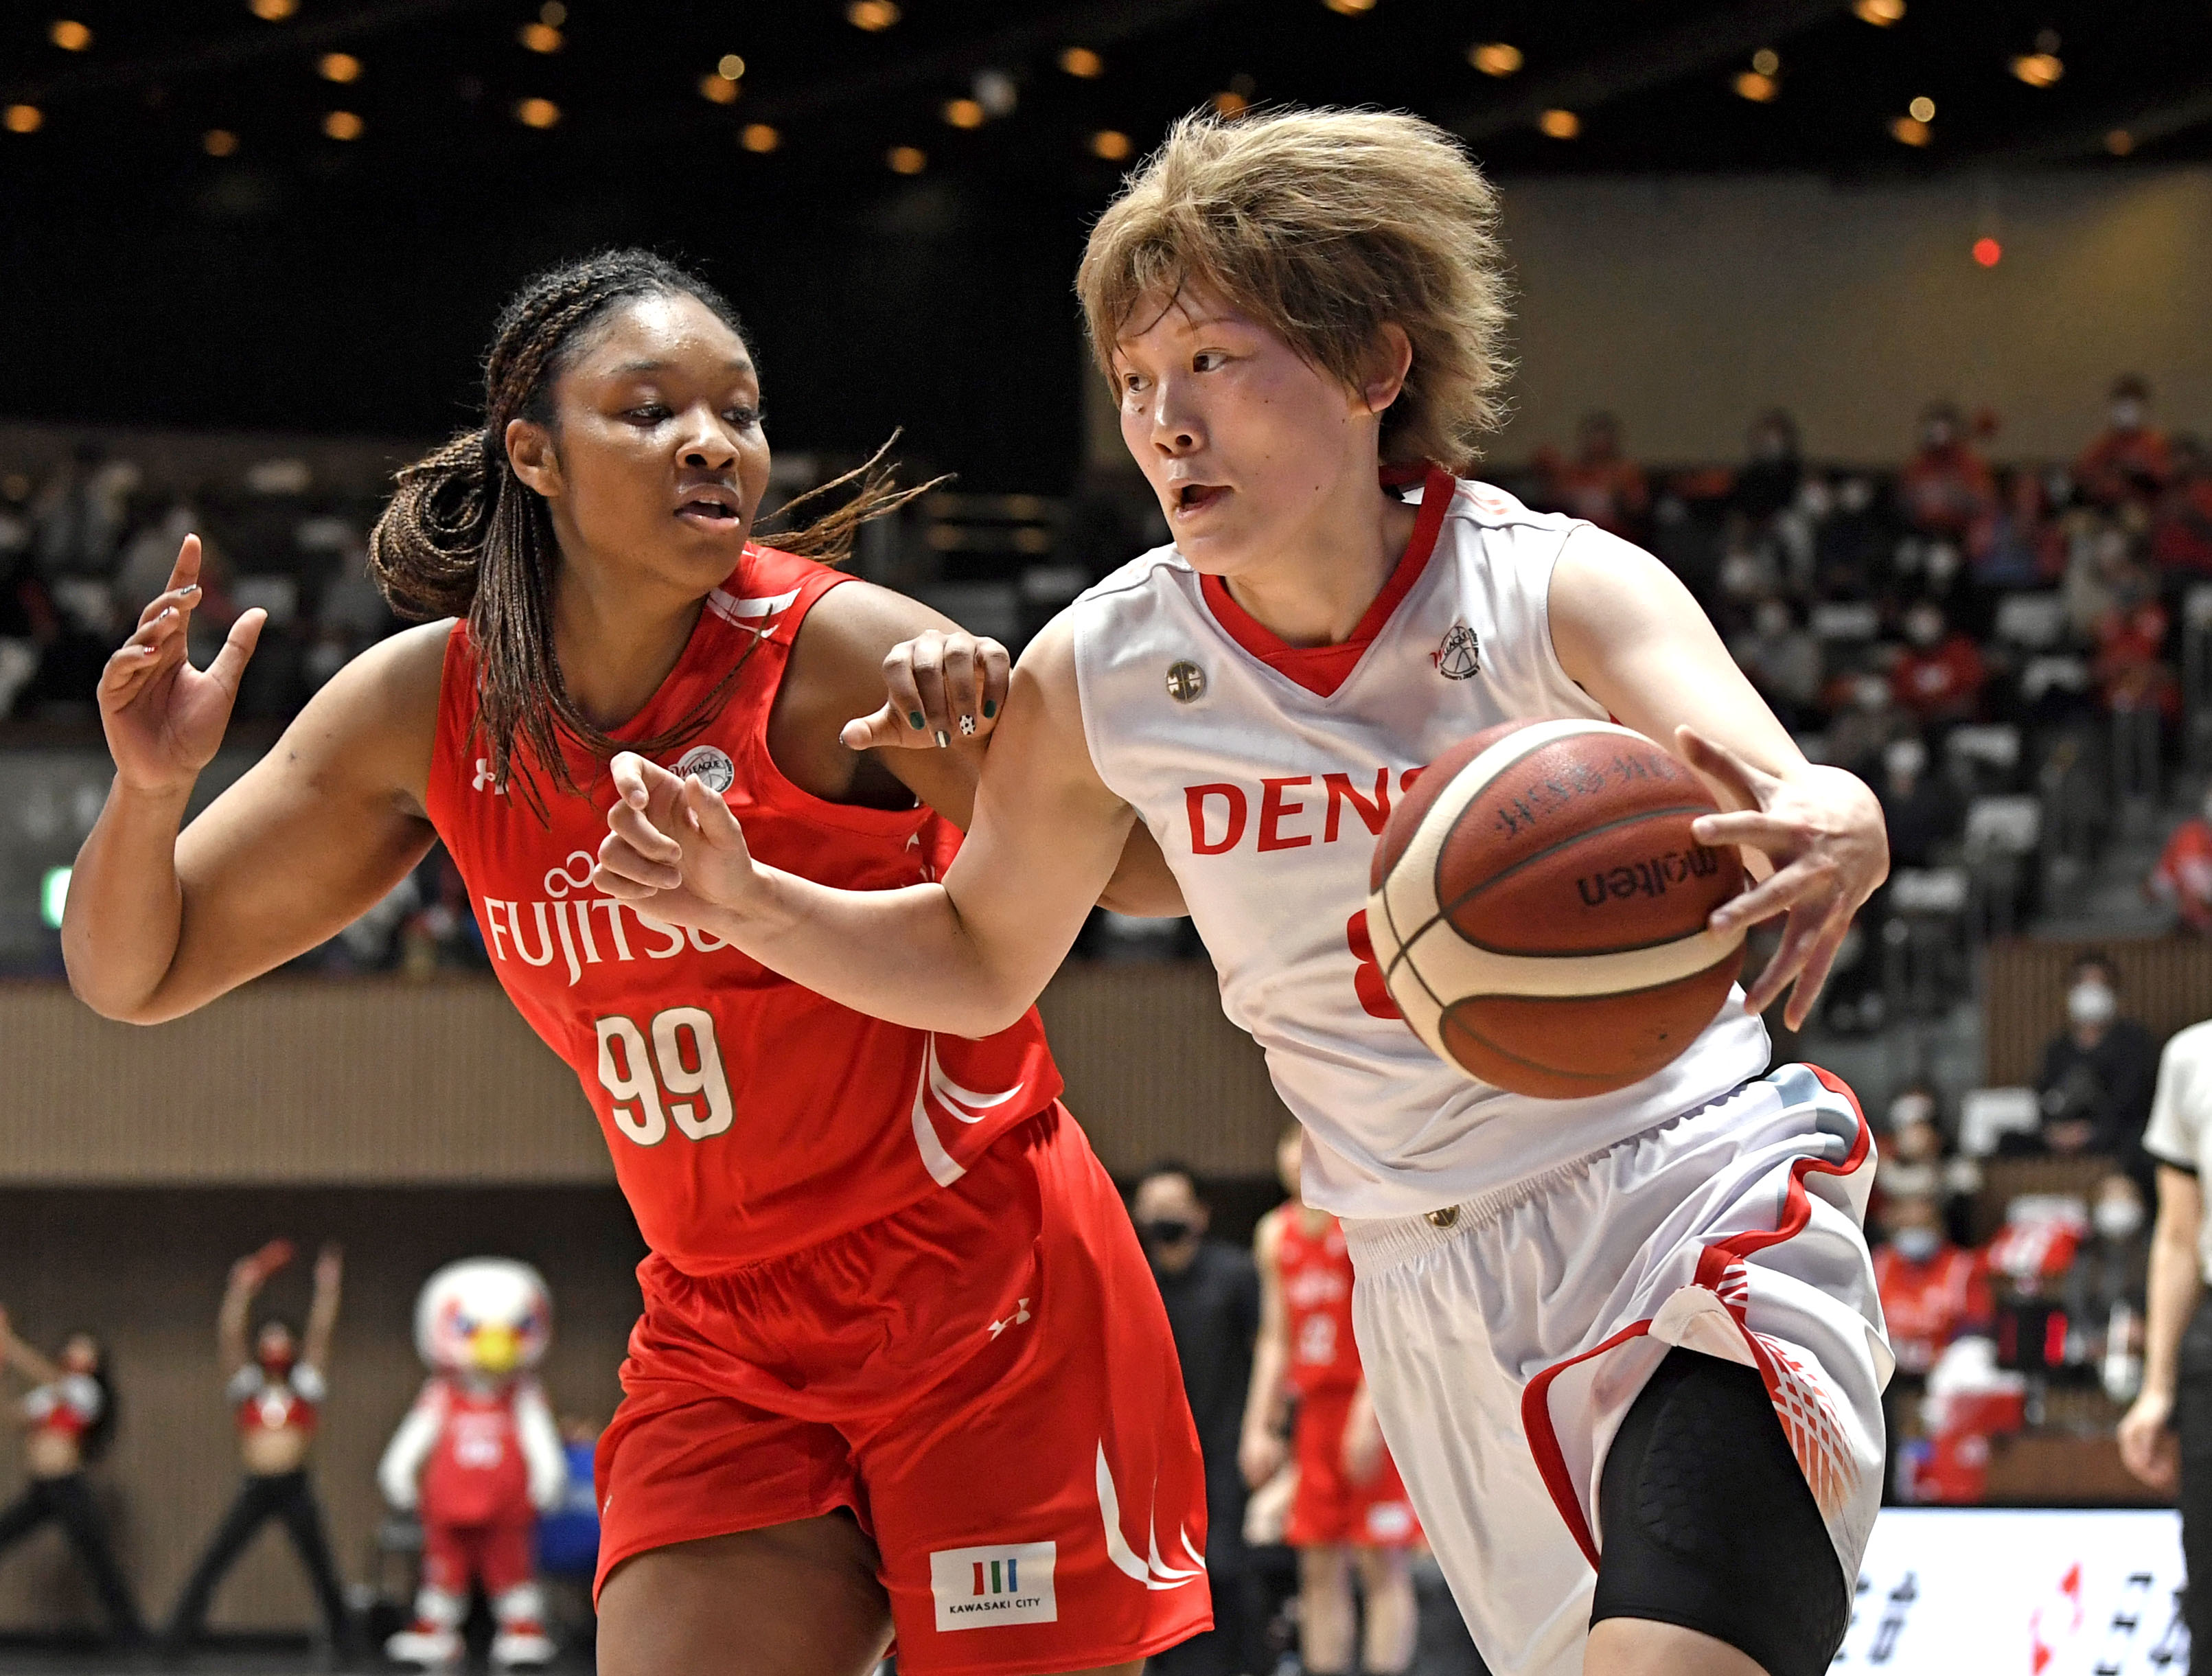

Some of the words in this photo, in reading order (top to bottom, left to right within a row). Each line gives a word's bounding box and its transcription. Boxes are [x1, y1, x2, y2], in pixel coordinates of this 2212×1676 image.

[689, 760, 720, 774] LEAGUE
[1184, 766, 1430, 855] DEN
[1577, 846, 1718, 907] molten
[595, 1006, 735, 1146] 99
[949, 1600, 1011, 1614] KAWASAKI
[1016, 1598, 1041, 1608] CITY
